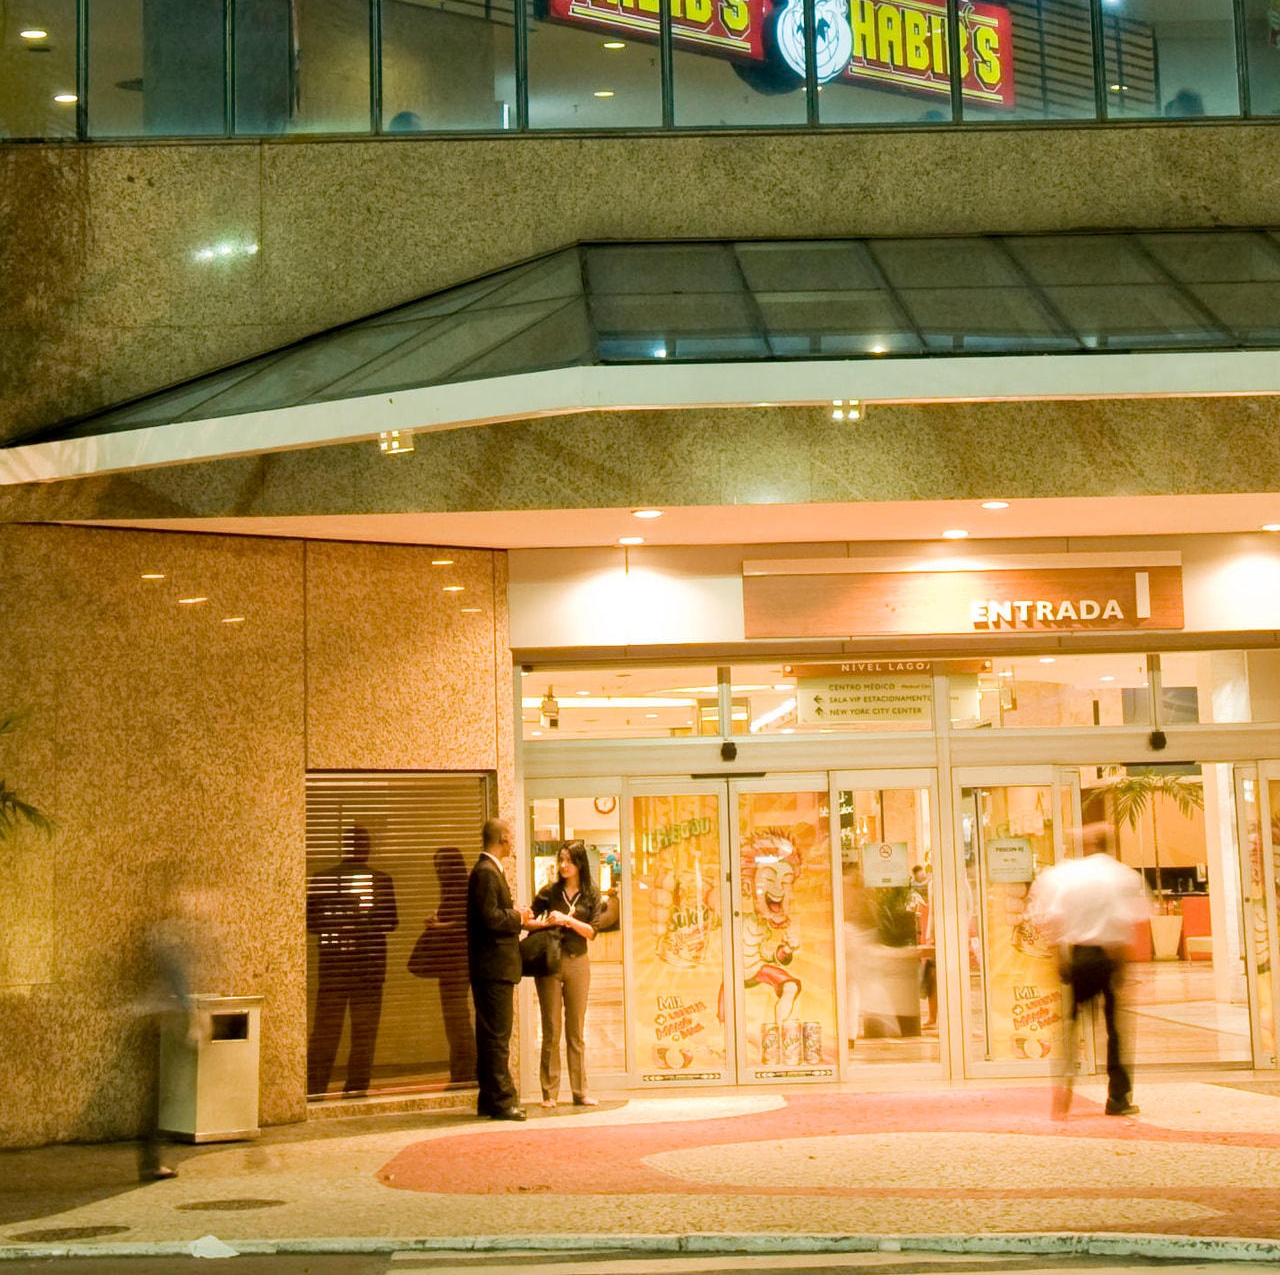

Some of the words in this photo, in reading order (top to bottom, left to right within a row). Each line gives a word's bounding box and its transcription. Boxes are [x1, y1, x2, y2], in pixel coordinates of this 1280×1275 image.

[971, 599, 1125, 622] ENTRADA
[829, 696, 847, 704] SALA
[830, 708, 847, 716] NEW
[872, 707, 889, 715] CITY
[892, 706, 922, 714] CENTER
